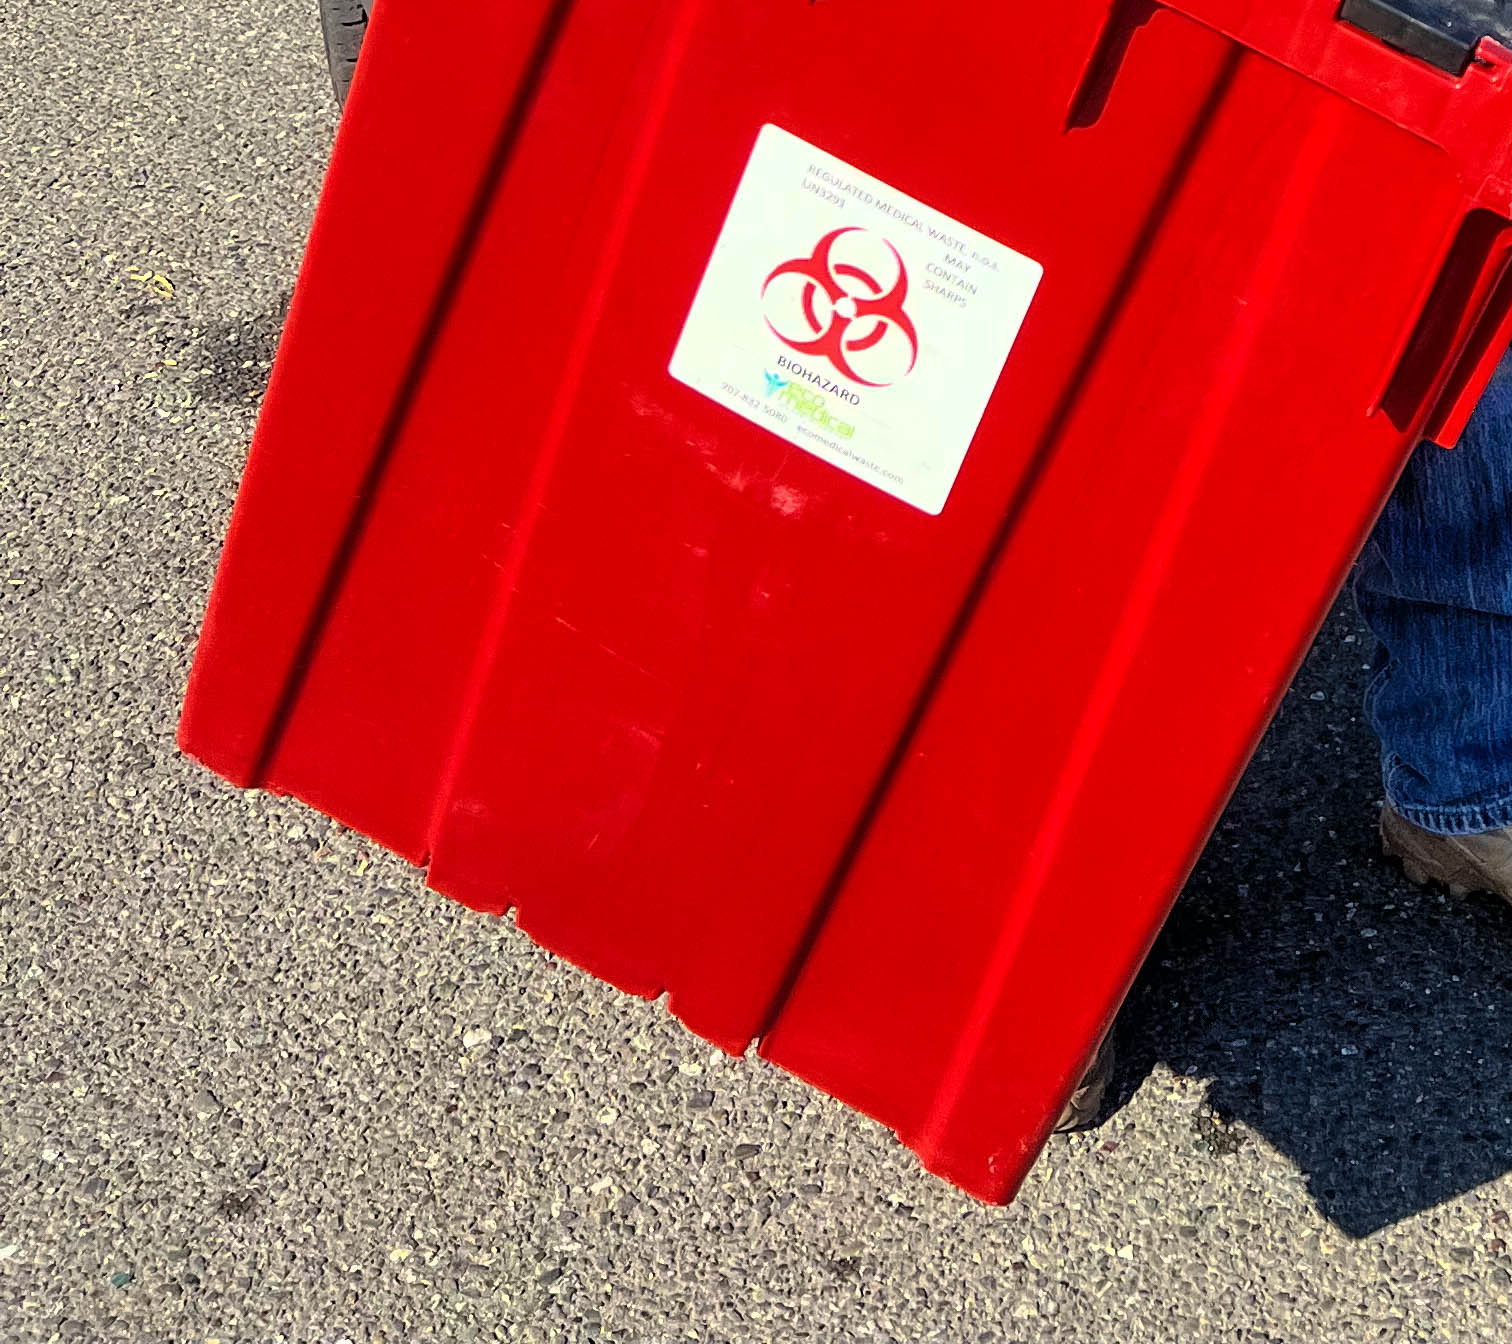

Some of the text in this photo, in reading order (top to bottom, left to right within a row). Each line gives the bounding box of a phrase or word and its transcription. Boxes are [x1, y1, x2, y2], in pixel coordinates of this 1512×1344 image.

[808, 164, 873, 204] REGULATED
[875, 199, 923, 233] MEDICAL
[925, 262, 978, 295] CONTAIN
[944, 253, 971, 273] MAY
[922, 279, 968, 308] SHARPS
[777, 355, 861, 406] BIOHAZARD
